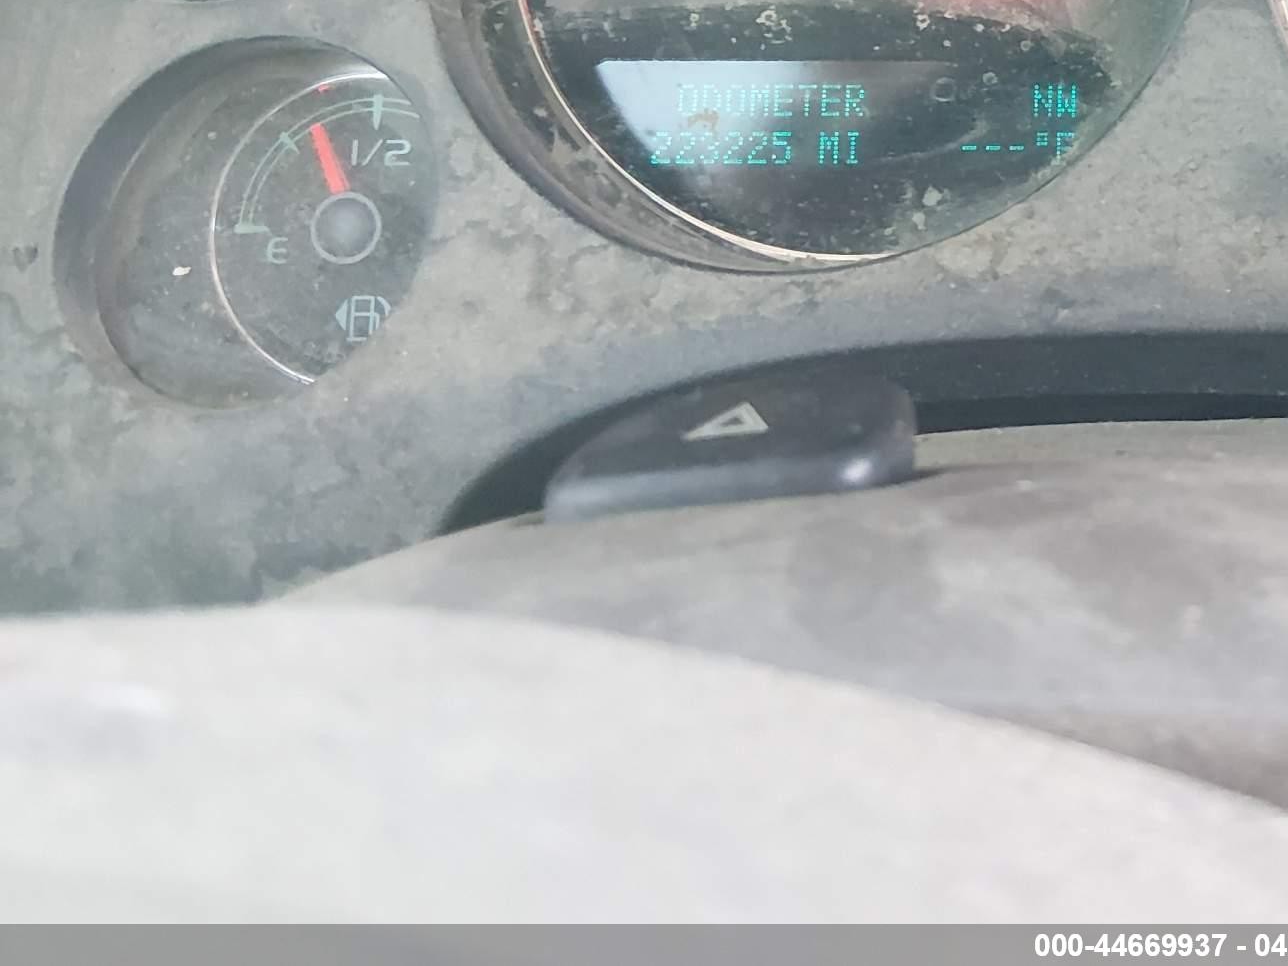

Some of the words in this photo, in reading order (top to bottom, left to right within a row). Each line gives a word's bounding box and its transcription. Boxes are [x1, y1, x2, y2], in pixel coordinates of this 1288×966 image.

[677, 84, 865, 117] ODOMETER
[1033, 83, 1077, 118] NW
[350, 139, 411, 166] 1/2
[650, 131, 792, 165] 223225
[818, 131, 860, 165] MI
[266, 237, 289, 264] E
